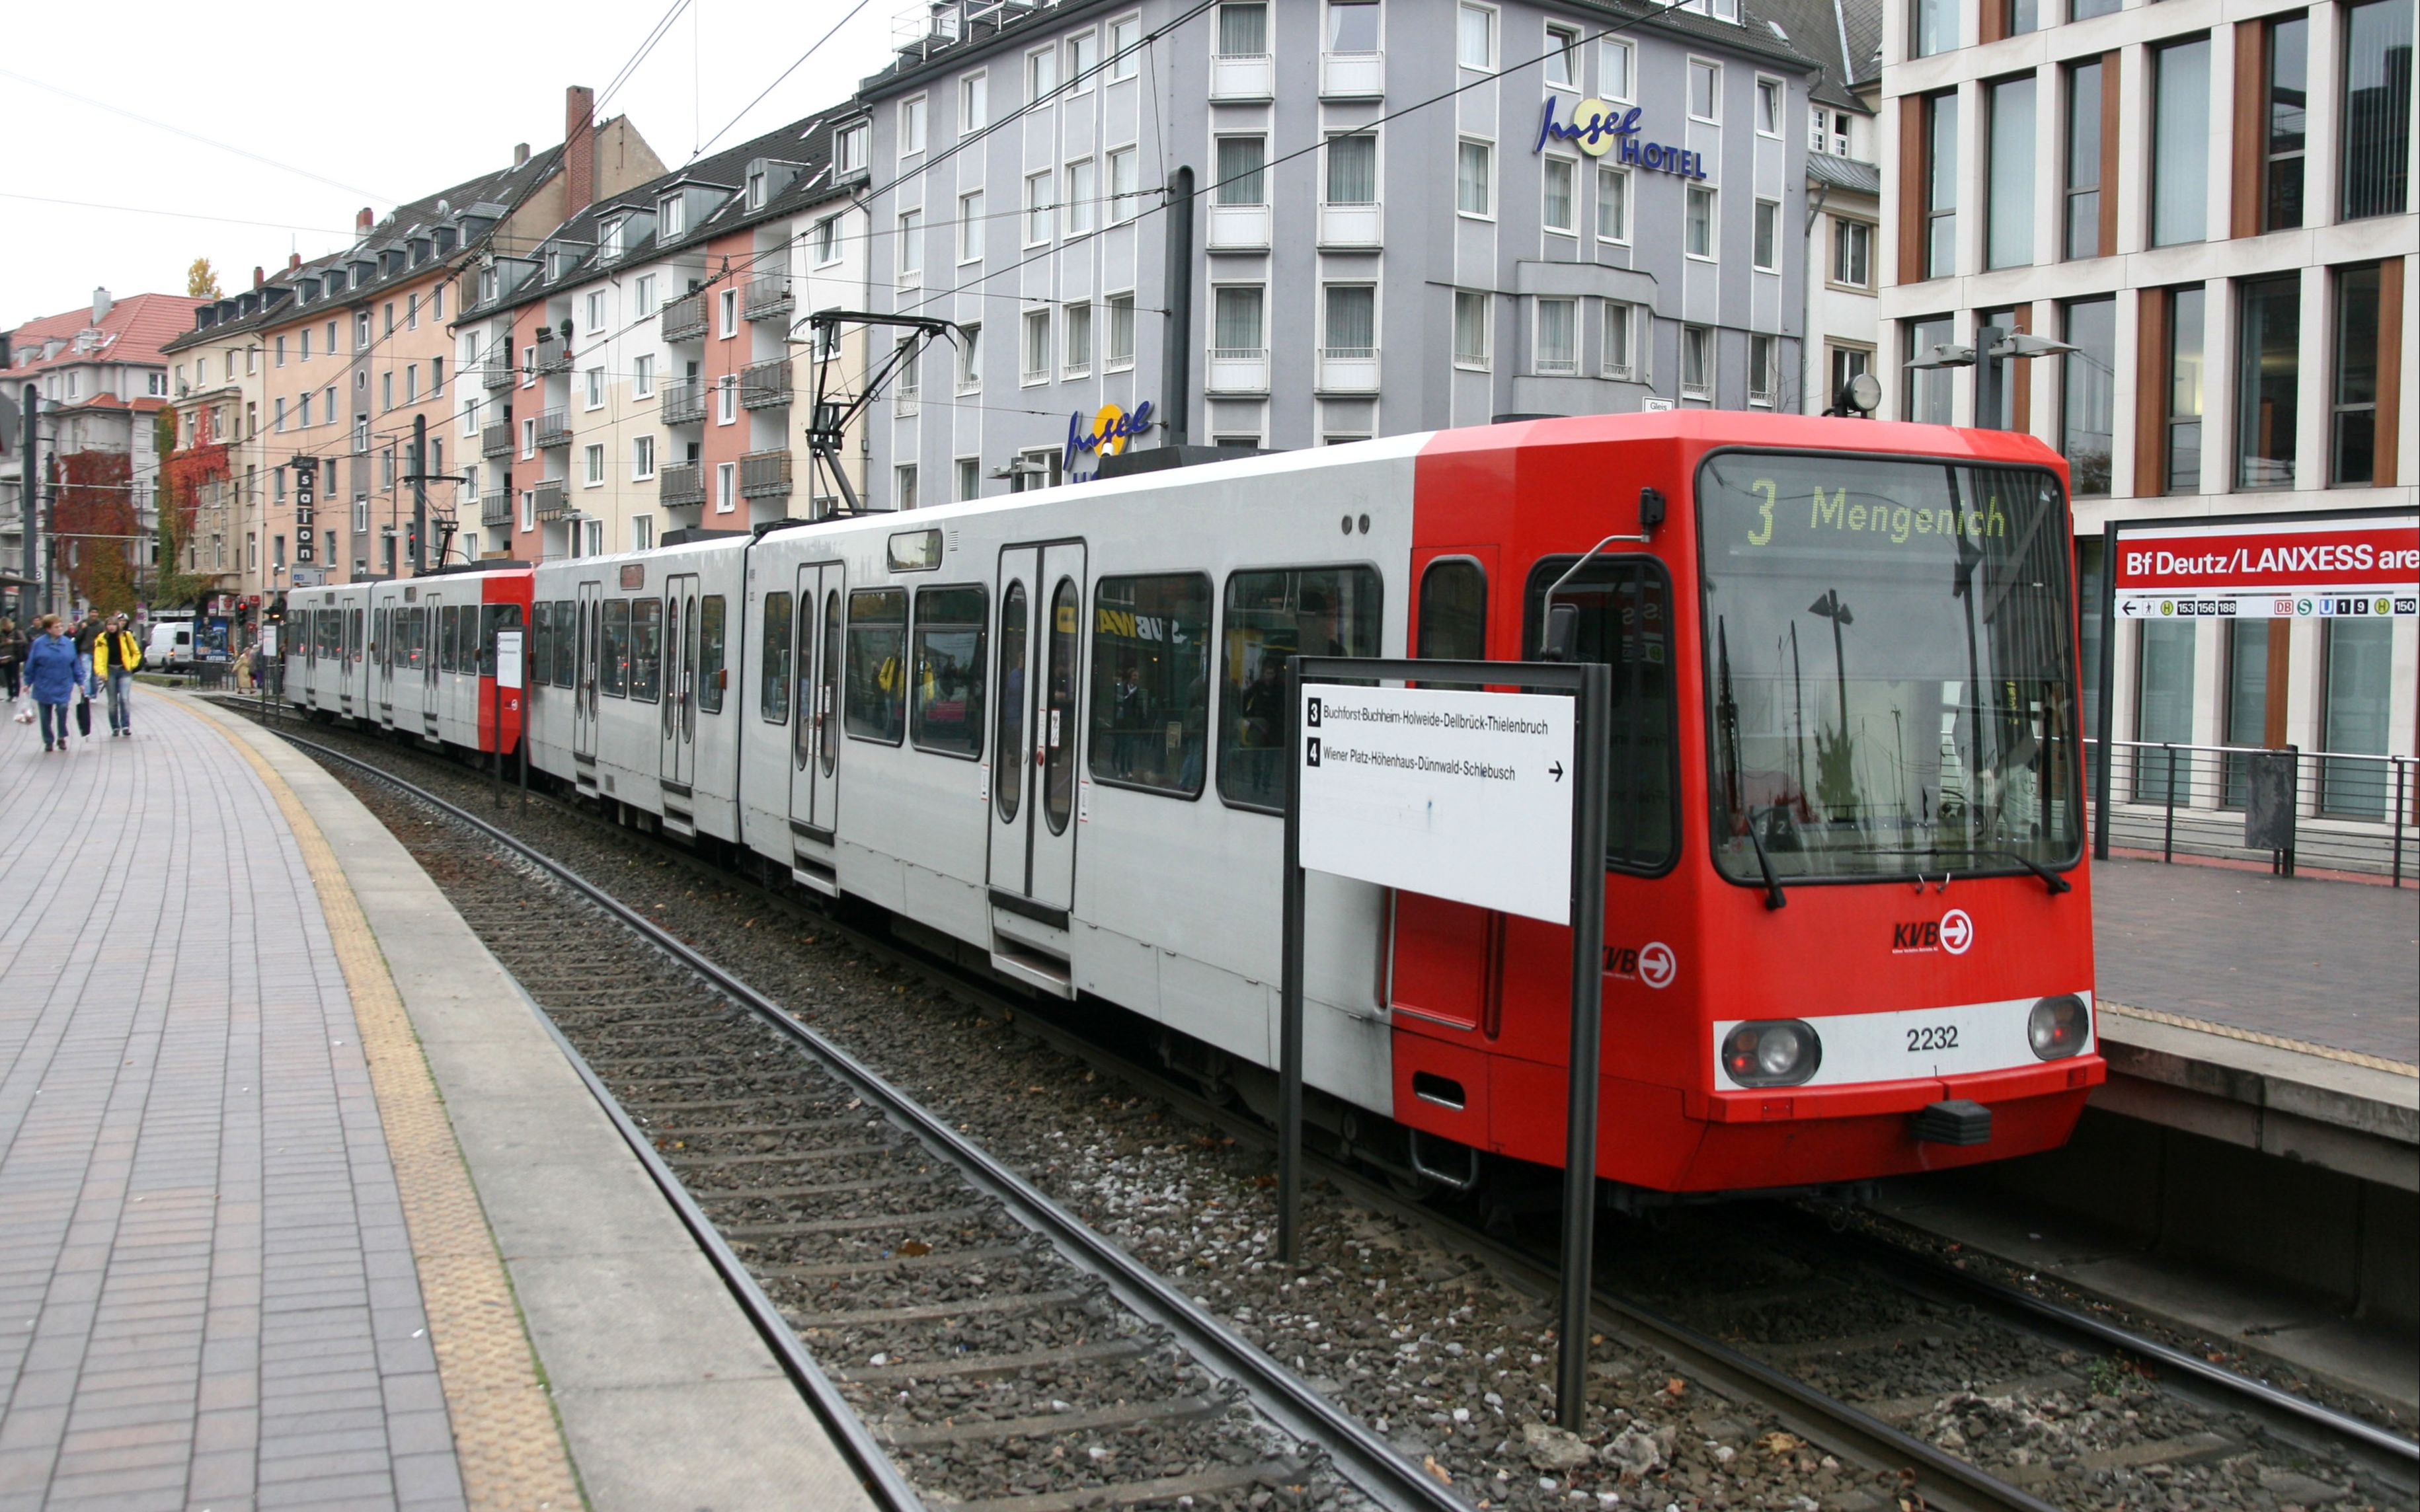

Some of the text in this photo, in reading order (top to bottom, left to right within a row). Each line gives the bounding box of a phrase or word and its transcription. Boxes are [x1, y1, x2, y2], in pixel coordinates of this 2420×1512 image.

[1535, 94, 1643, 153] Insel
[1621, 136, 1707, 179] HOTEL
[299, 474, 311, 559] salon
[1746, 477, 2006, 546] 3 Mengenich
[2126, 551, 2153, 576] Bf
[2156, 544, 2374, 575] Deutz/LANXESS
[2177, 603, 2195, 613] 153
[2197, 603, 2215, 613] 156
[2218, 602, 2236, 613] 188
[2276, 601, 2292, 613] DB
[2340, 601, 2346, 612] 1
[2357, 601, 2364, 612] 9
[2395, 601, 2415, 612] 150
[1309, 702, 1318, 723] 3
[1309, 742, 1317, 762] 4
[1323, 745, 1348, 761] Wiener
[1893, 921, 1939, 948] KVB
[1906, 1024, 1959, 1053] 2232
